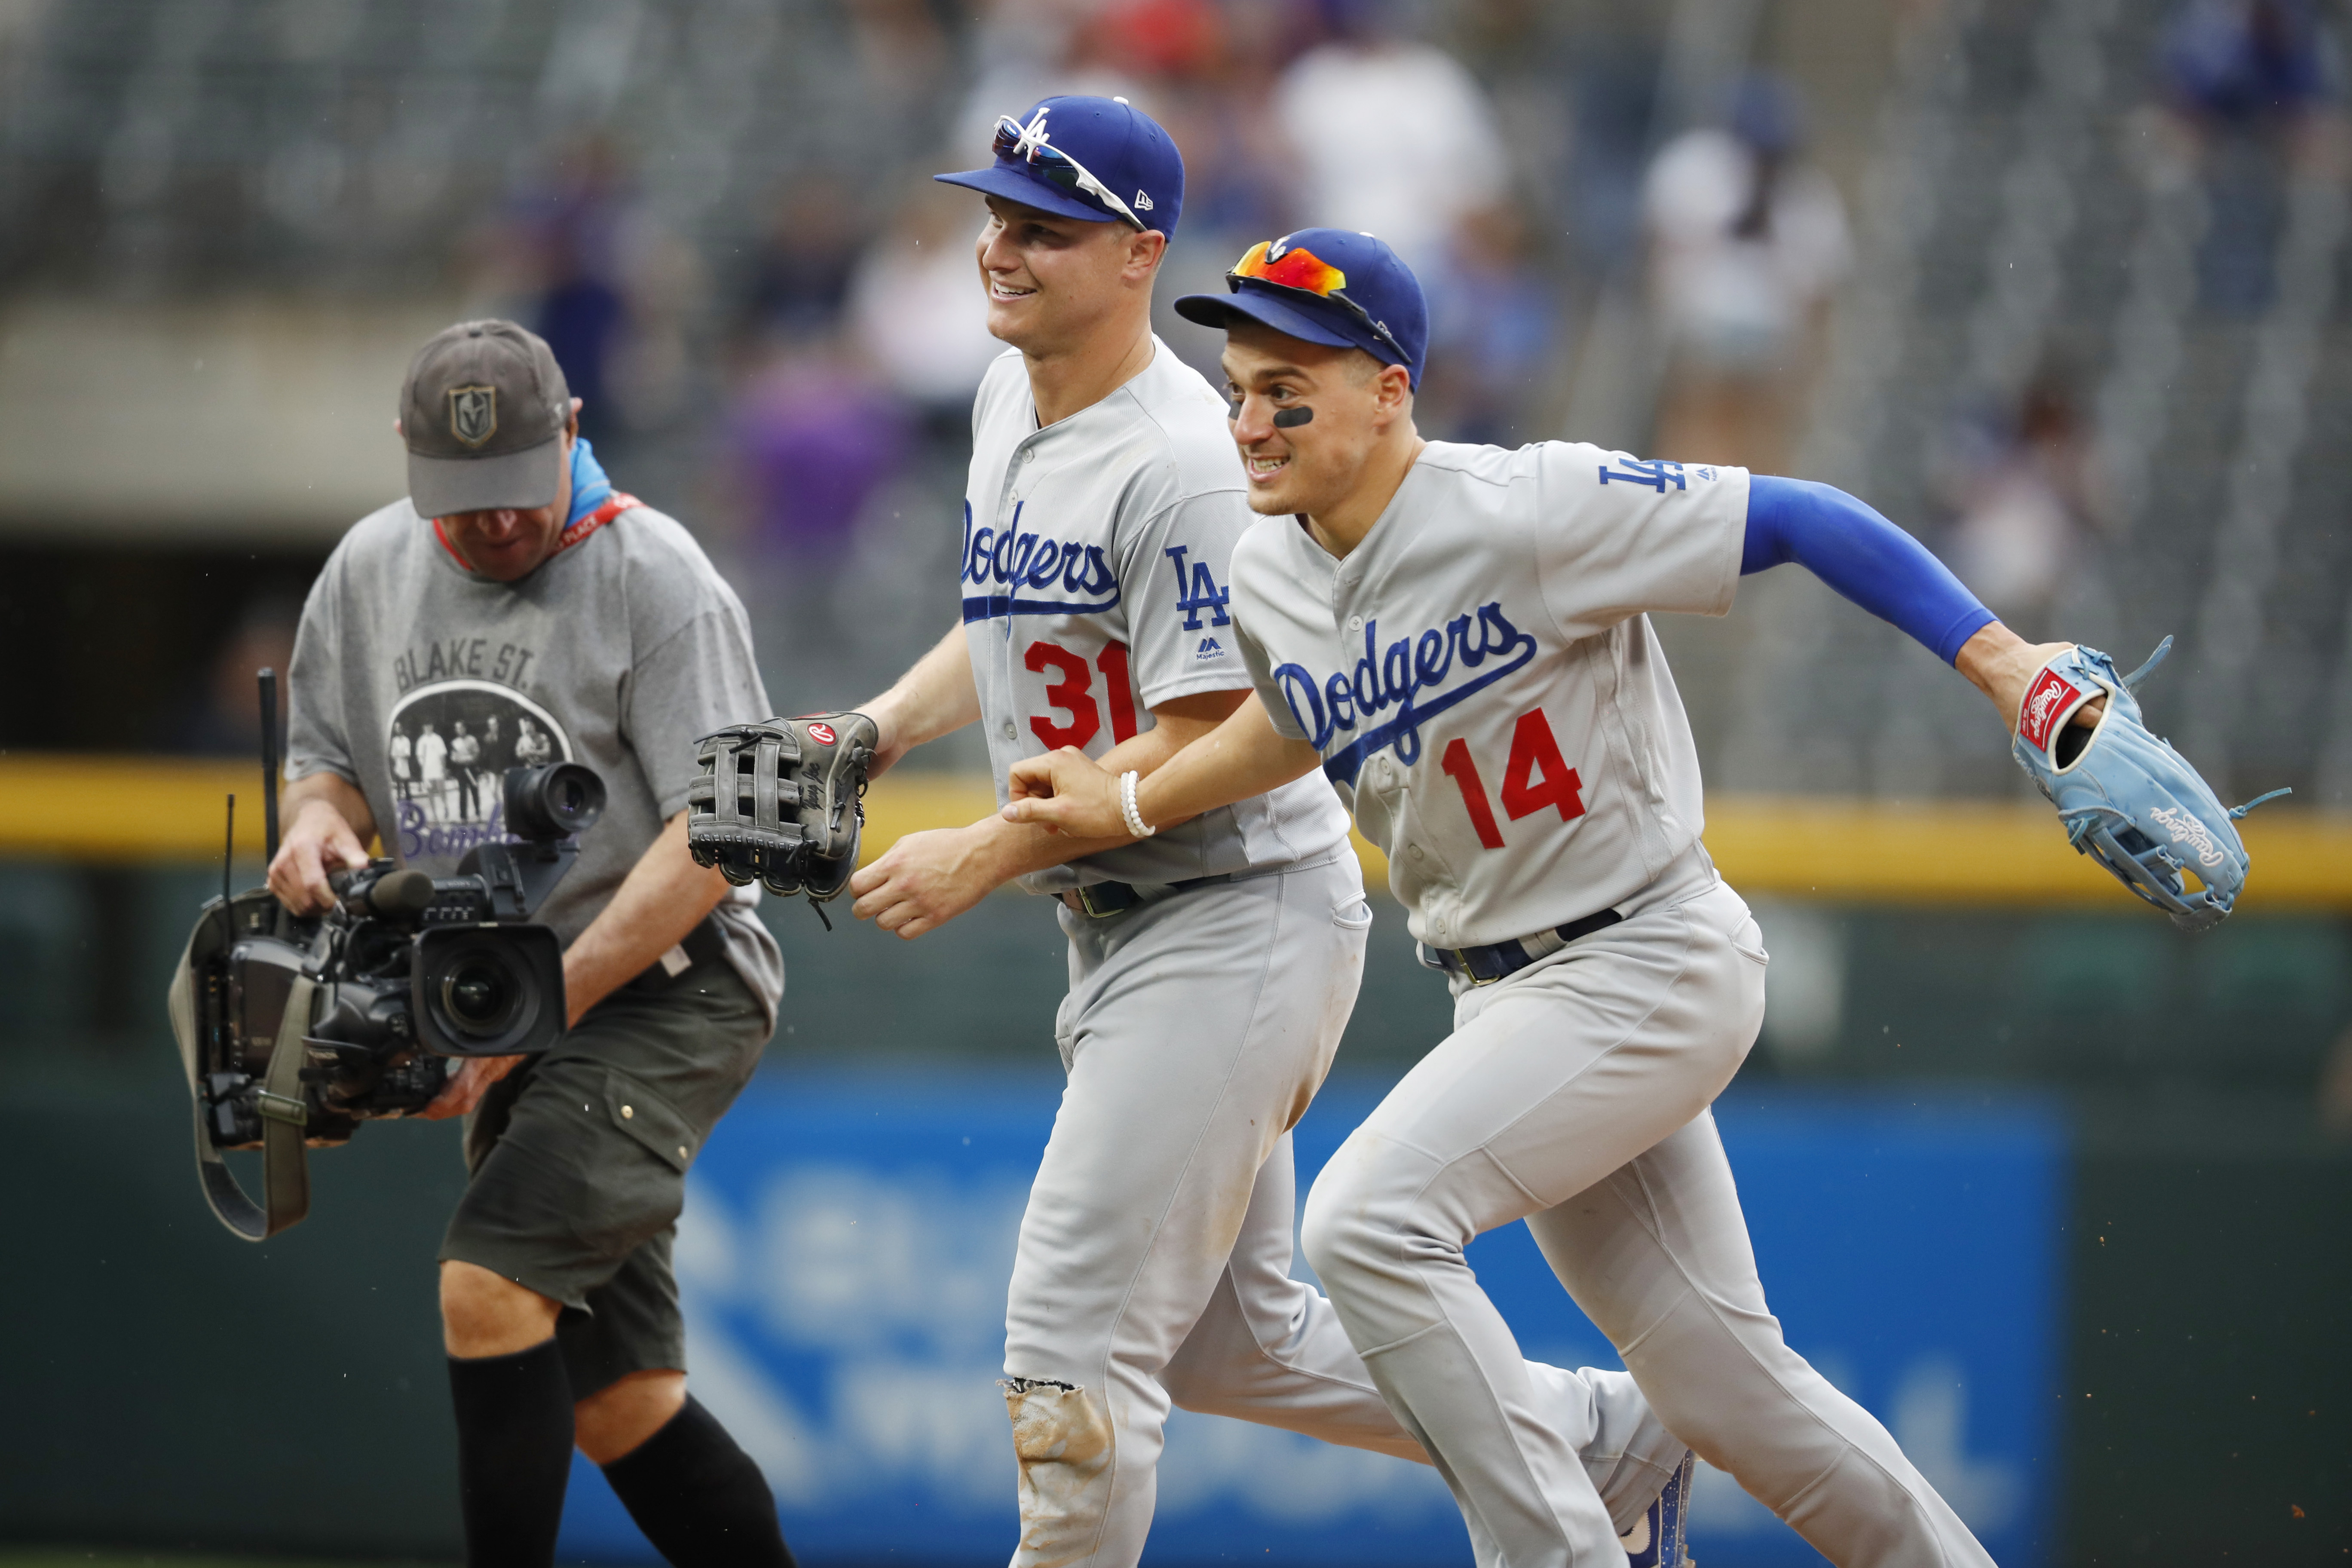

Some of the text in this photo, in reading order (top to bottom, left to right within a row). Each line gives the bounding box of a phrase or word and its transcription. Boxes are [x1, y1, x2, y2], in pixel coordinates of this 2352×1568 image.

[1599, 458, 1686, 493] LA
[1165, 545, 1230, 631] LA
[394, 638, 535, 690] BLAKE ST.
[1196, 650, 1224, 660] Majestic
[1274, 602, 1537, 768] Dodgers
[1024, 639, 1137, 750] 31
[2030, 680, 2062, 739] Rawlings
[1441, 707, 1586, 849] 14
[2150, 806, 2224, 867] Rawlings
